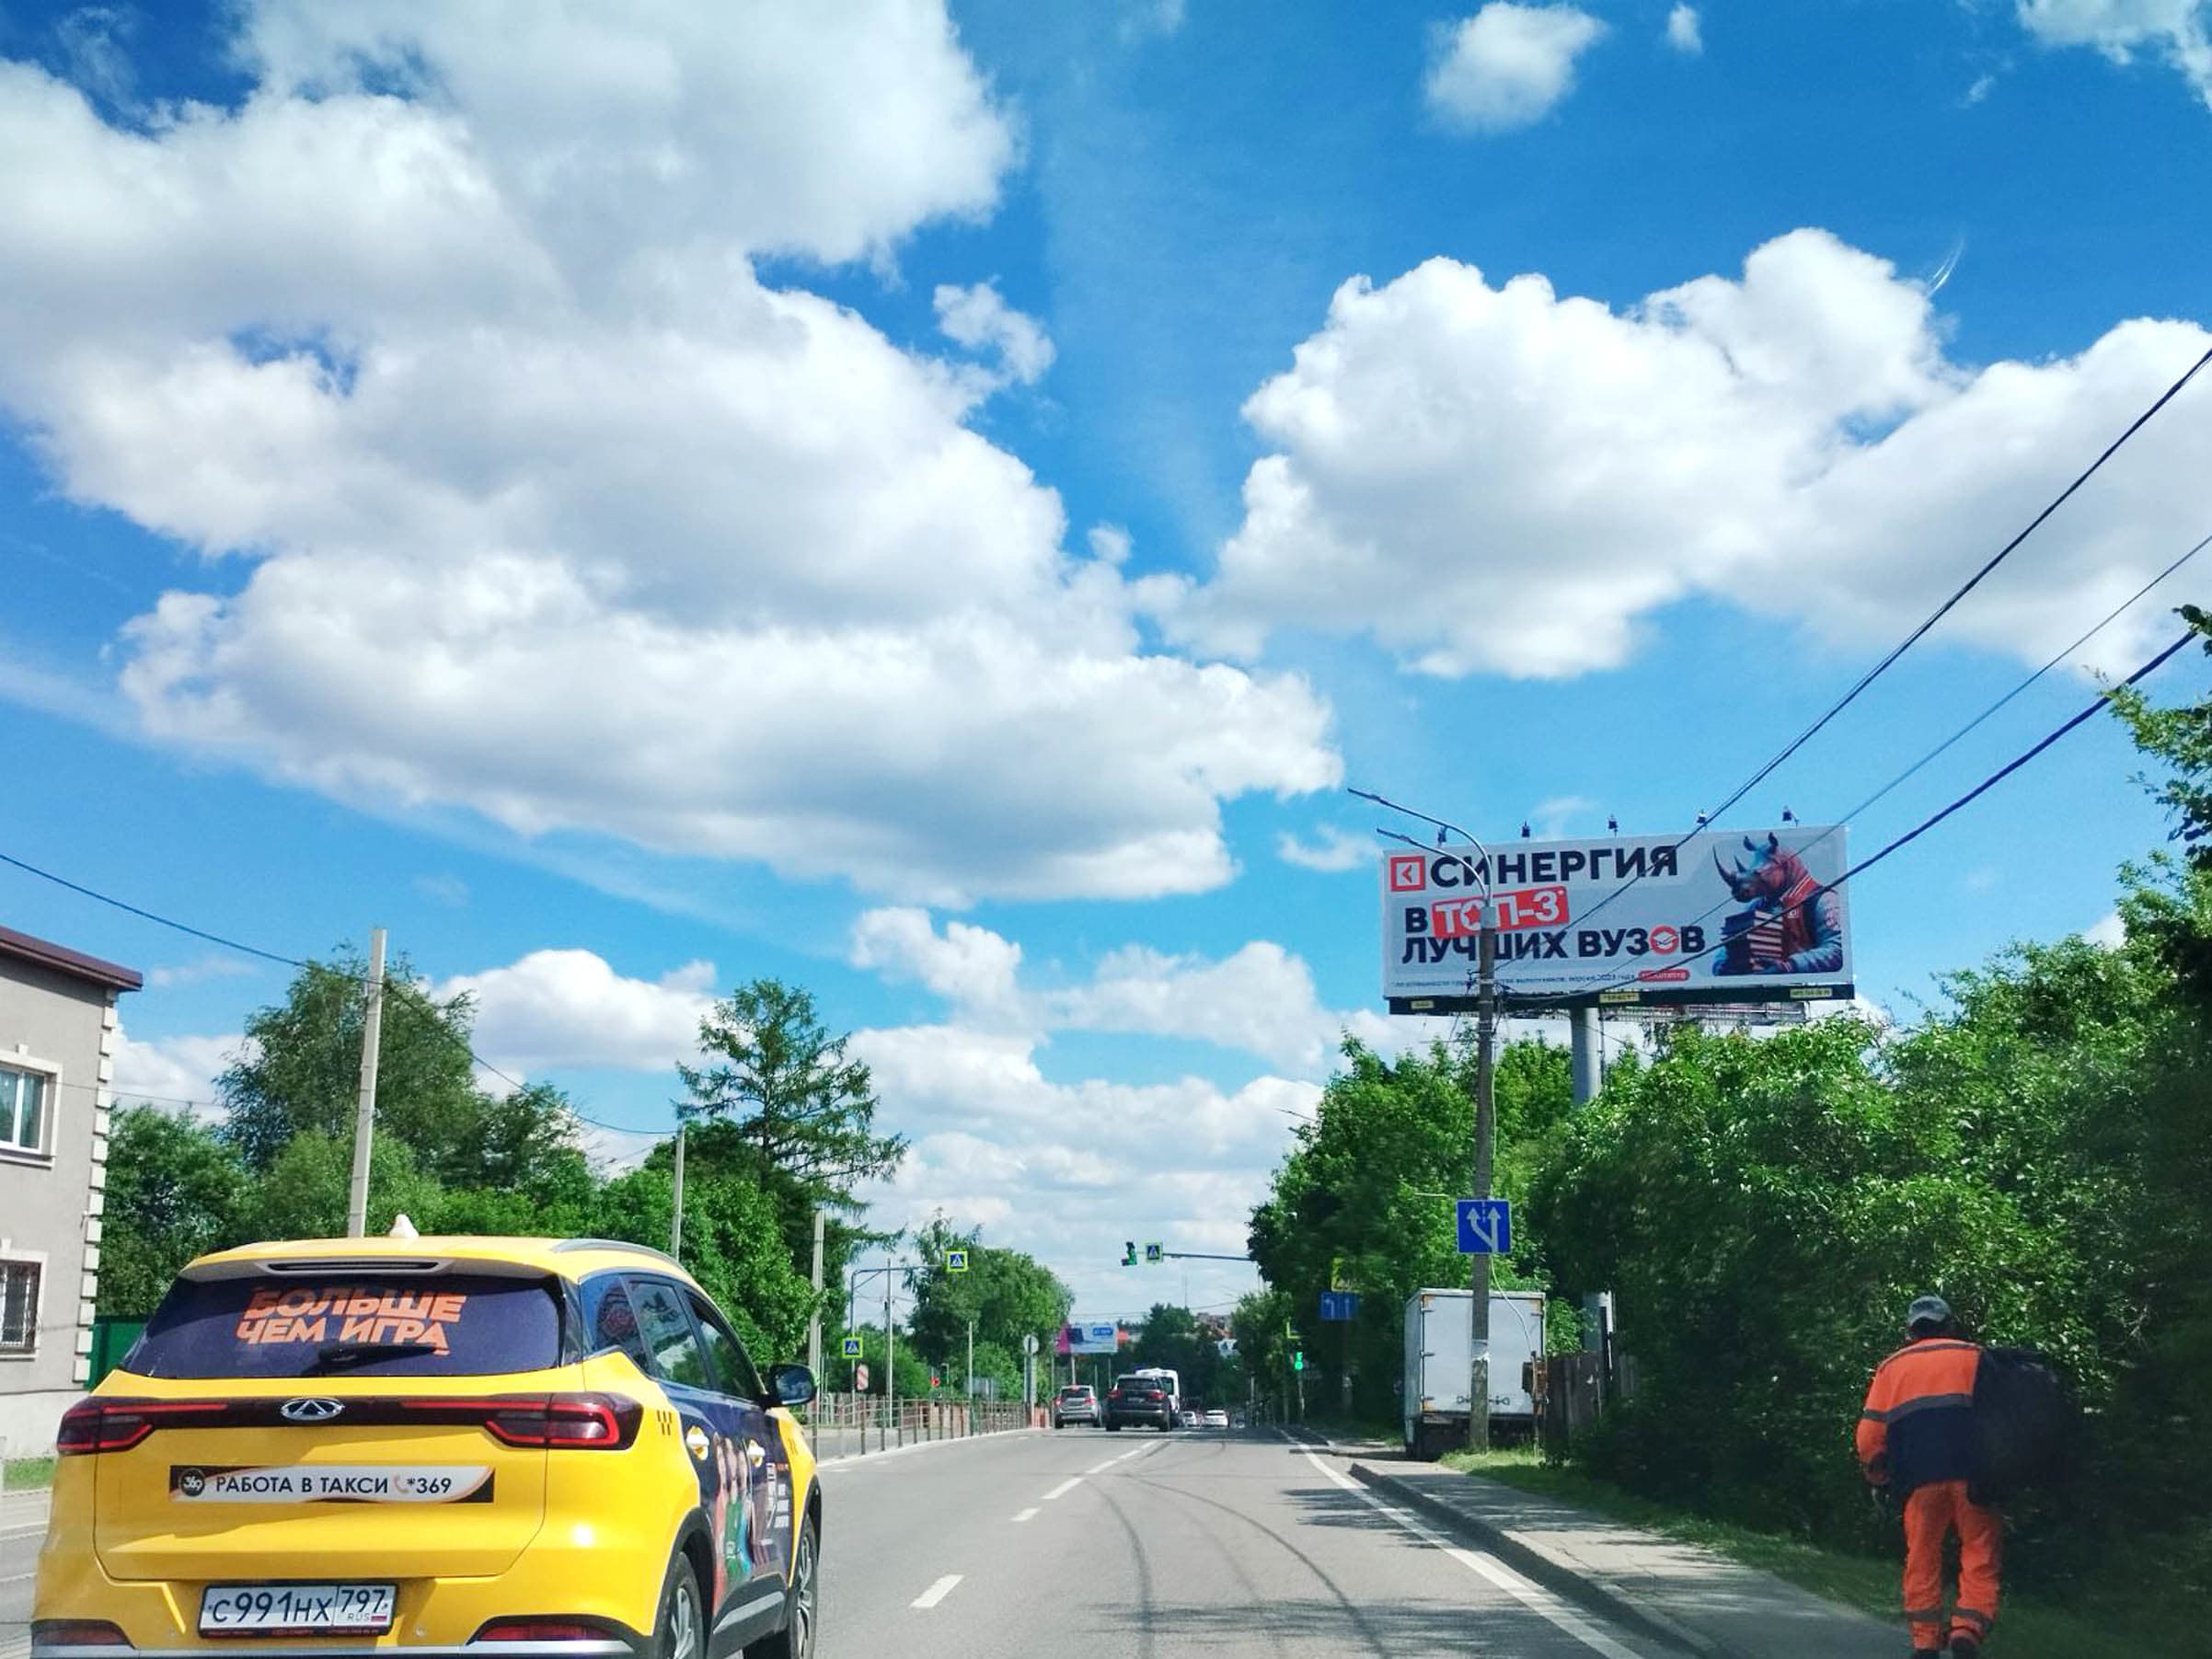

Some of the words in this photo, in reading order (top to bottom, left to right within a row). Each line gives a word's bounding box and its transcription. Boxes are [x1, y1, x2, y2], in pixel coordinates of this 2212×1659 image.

[1431, 846, 1677, 888] СИНЕРГИЯ
[1405, 906, 1428, 933] В
[1579, 925, 1705, 958] ВУЗОВ
[244, 1287, 467, 1322] БОЛЬШЕ
[236, 1318, 327, 1344] ЧЕМ
[339, 1318, 451, 1356] ИГРА
[182, 1475, 202, 1491] 369
[215, 1476, 293, 1493] РАБОТА
[301, 1477, 313, 1492] В
[320, 1477, 388, 1493] ТАКСИ
[340, 1589, 386, 1613] 797
